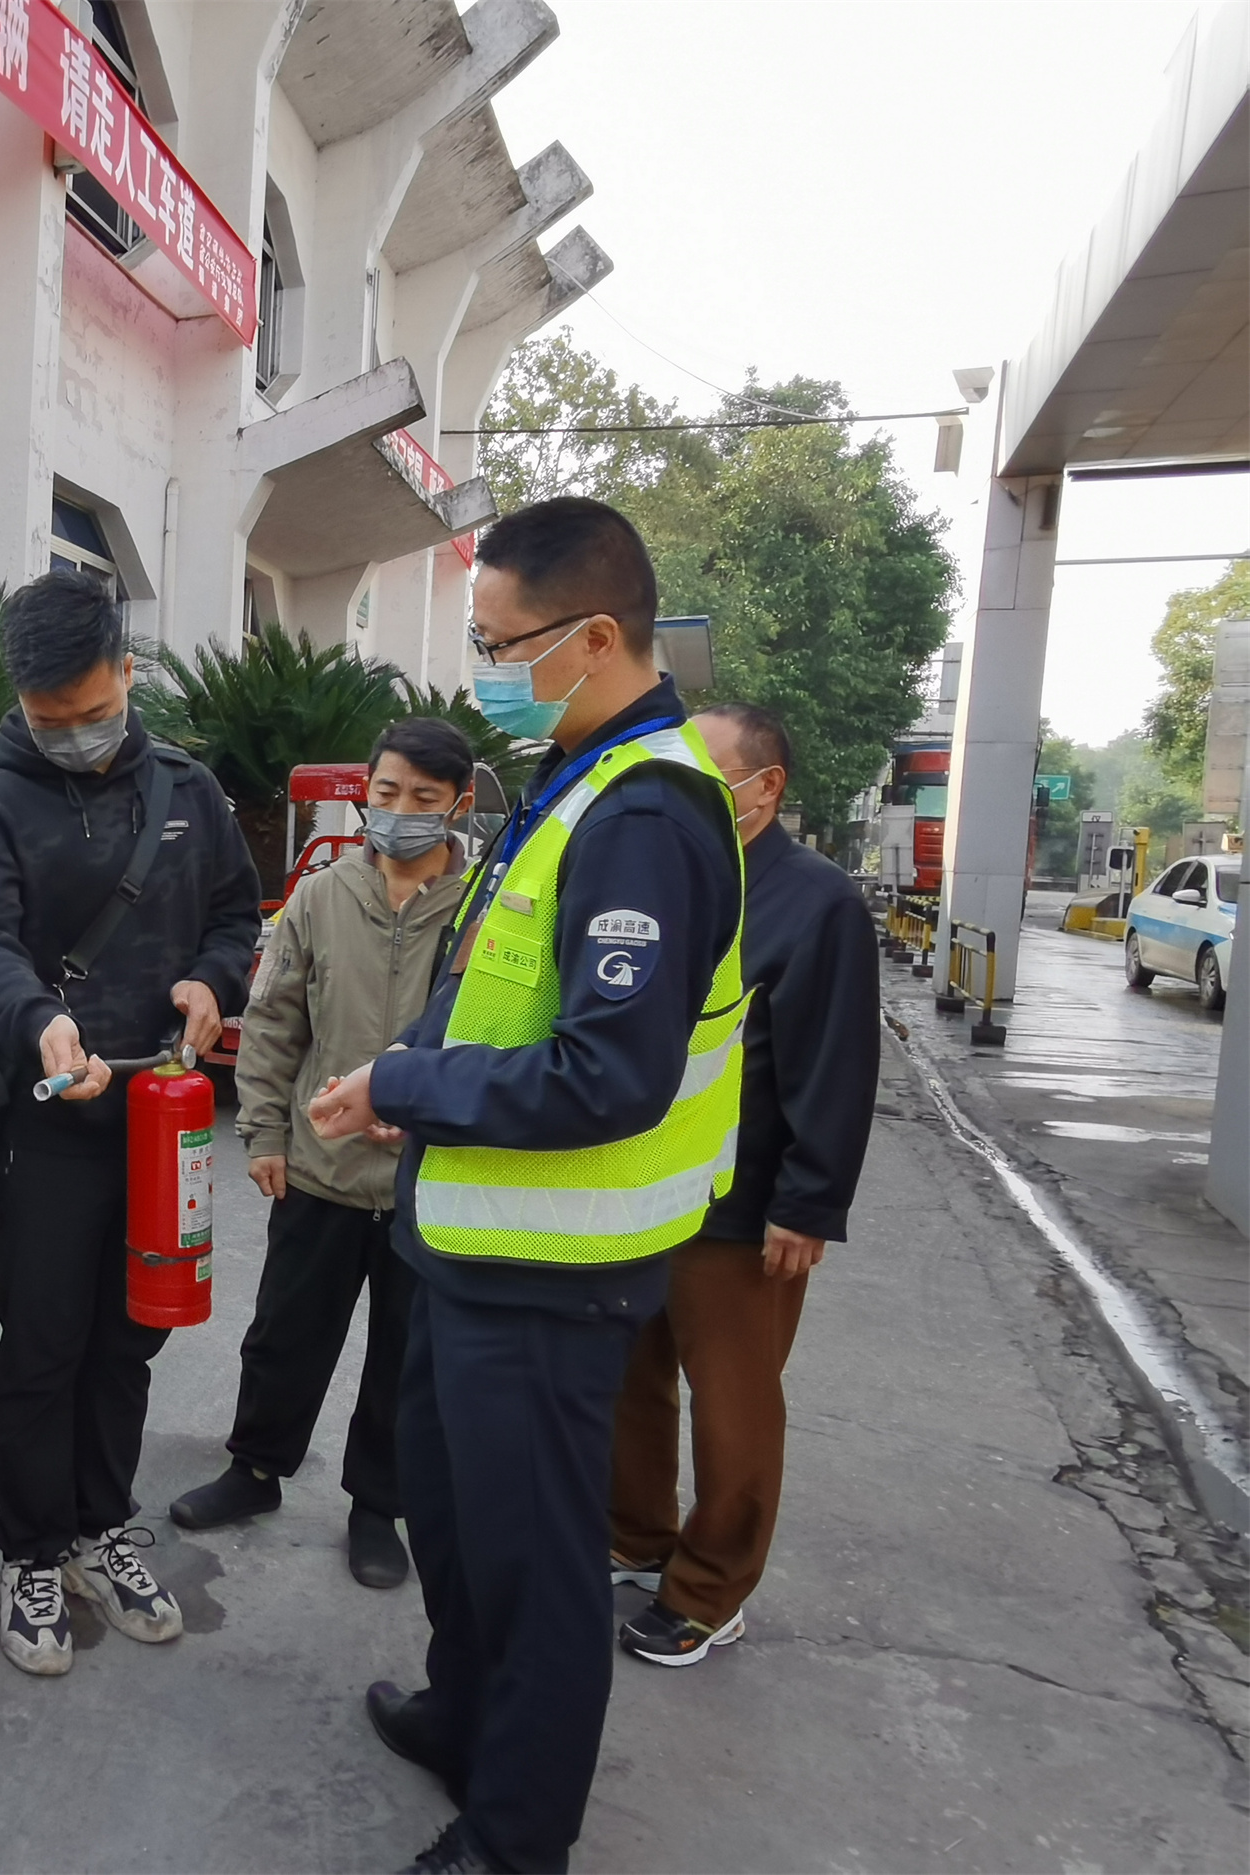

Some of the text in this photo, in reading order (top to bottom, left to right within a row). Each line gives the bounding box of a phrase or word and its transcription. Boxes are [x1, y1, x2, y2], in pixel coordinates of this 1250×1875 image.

[61, 28, 194, 270] 请走人工车道
[597, 918, 651, 935] 成渝高速
[502, 950, 537, 970] 成渝公司
